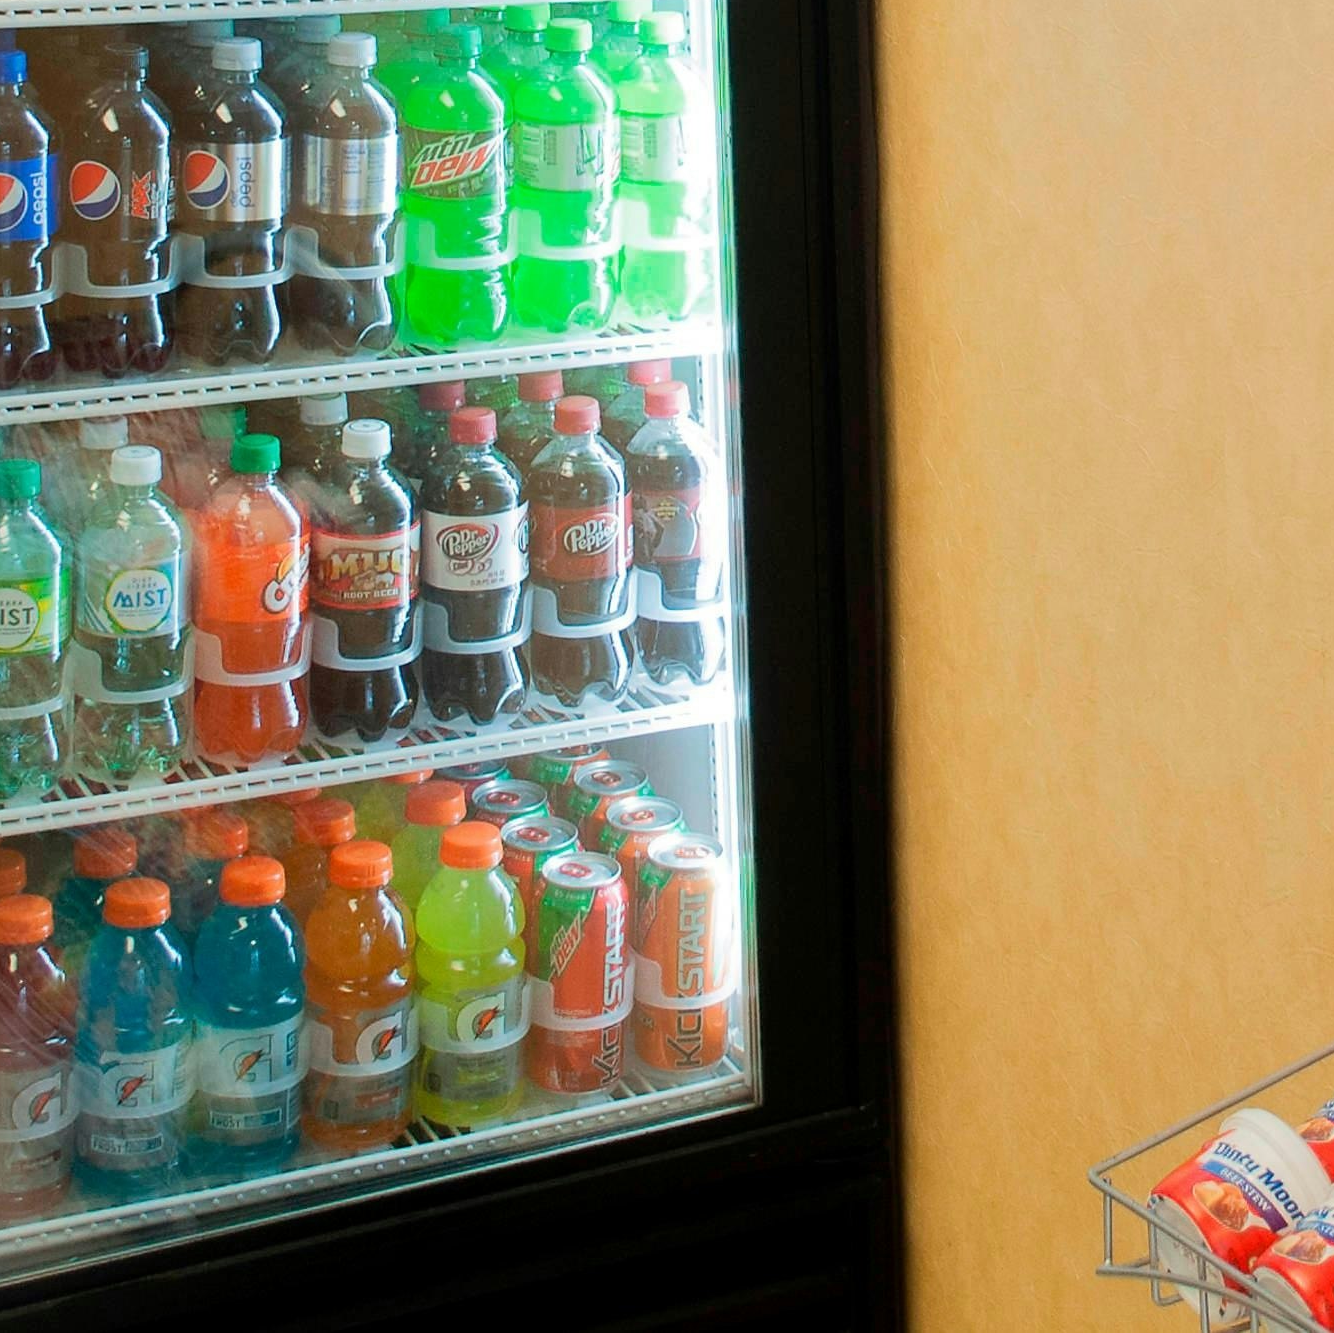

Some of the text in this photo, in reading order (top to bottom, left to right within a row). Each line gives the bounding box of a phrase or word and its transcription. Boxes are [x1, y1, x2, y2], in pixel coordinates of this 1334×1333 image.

[410, 144, 495, 188] DEW
[236, 157, 255, 208] pepsi
[32, 172, 47, 226] pepsi
[461, 528, 479, 544] Dr
[565, 522, 620, 554] Pepper
[585, 518, 607, 537] Dr
[446, 531, 491, 557] Pepper
[113, 587, 167, 609] MIST
[342, 588, 400, 600] ROOT BEER
[1214, 1141, 1257, 1174] Dinty
[1257, 1168, 1306, 1222] Moor
[1245, 1186, 1272, 1213] STEW
